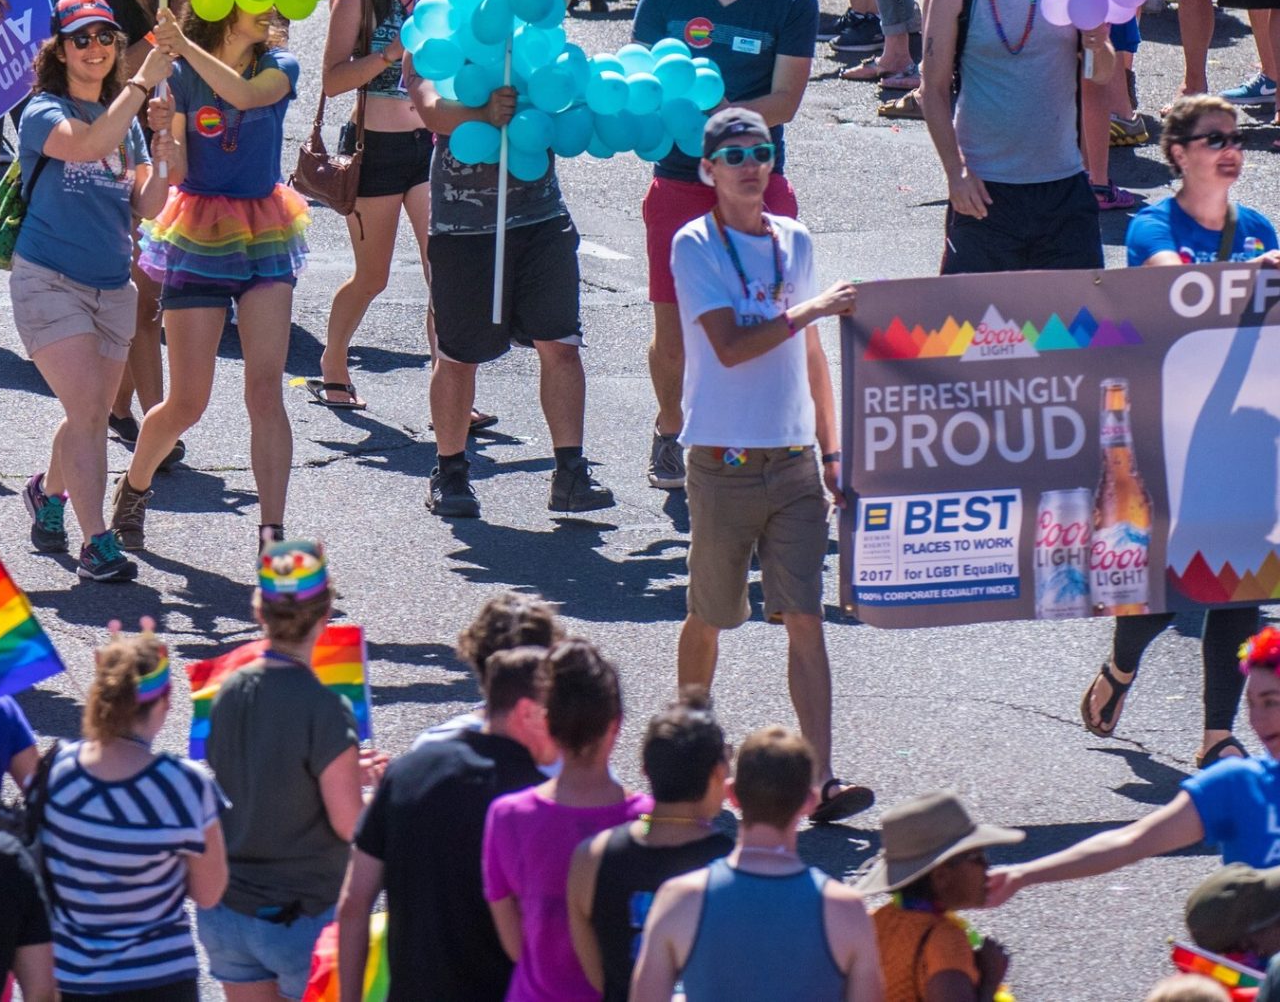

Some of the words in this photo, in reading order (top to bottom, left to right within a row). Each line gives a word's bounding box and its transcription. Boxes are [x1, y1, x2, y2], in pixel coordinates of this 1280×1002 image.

[971, 323, 1026, 345] Coors
[980, 344, 1016, 357] LIGHT
[864, 374, 1084, 413] REFRESHINGLY
[865, 405, 1087, 472] PROUD
[904, 494, 1017, 535] BEST
[903, 540, 952, 555] PLACES
[954, 539, 972, 552] TO
[973, 536, 1015, 550] WORK
[860, 569, 893, 582] 2017
[904, 568, 923, 580] for
[925, 564, 960, 579] LGBT
[963, 563, 1015, 578] Equality
[1096, 569, 1145, 587] LIGHT
[884, 589, 939, 601] CORPORATE
[941, 586, 984, 597] EQUALITY
[985, 584, 1016, 595] INDEX
